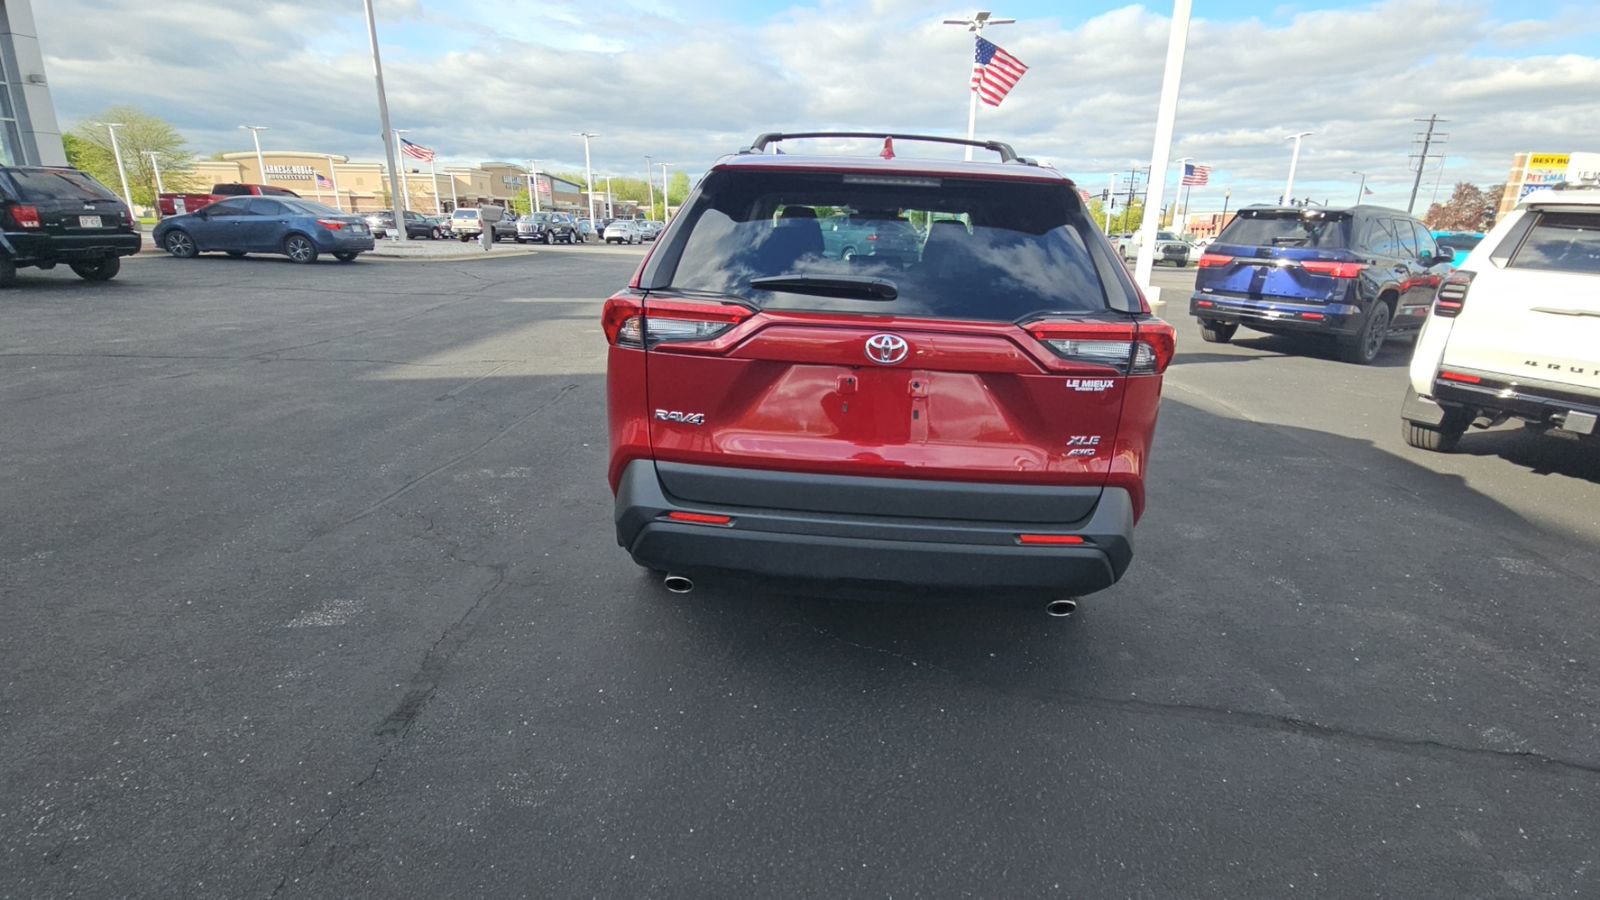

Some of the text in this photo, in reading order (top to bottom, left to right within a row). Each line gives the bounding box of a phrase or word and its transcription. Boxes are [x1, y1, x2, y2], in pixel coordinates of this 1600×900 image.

[1557, 157, 1570, 165] BU
[265, 164, 287, 174] ARNES
[1066, 379, 1114, 388] LE MIEUX
[655, 409, 705, 425] RAV4
[1066, 435, 1101, 446] XLE
